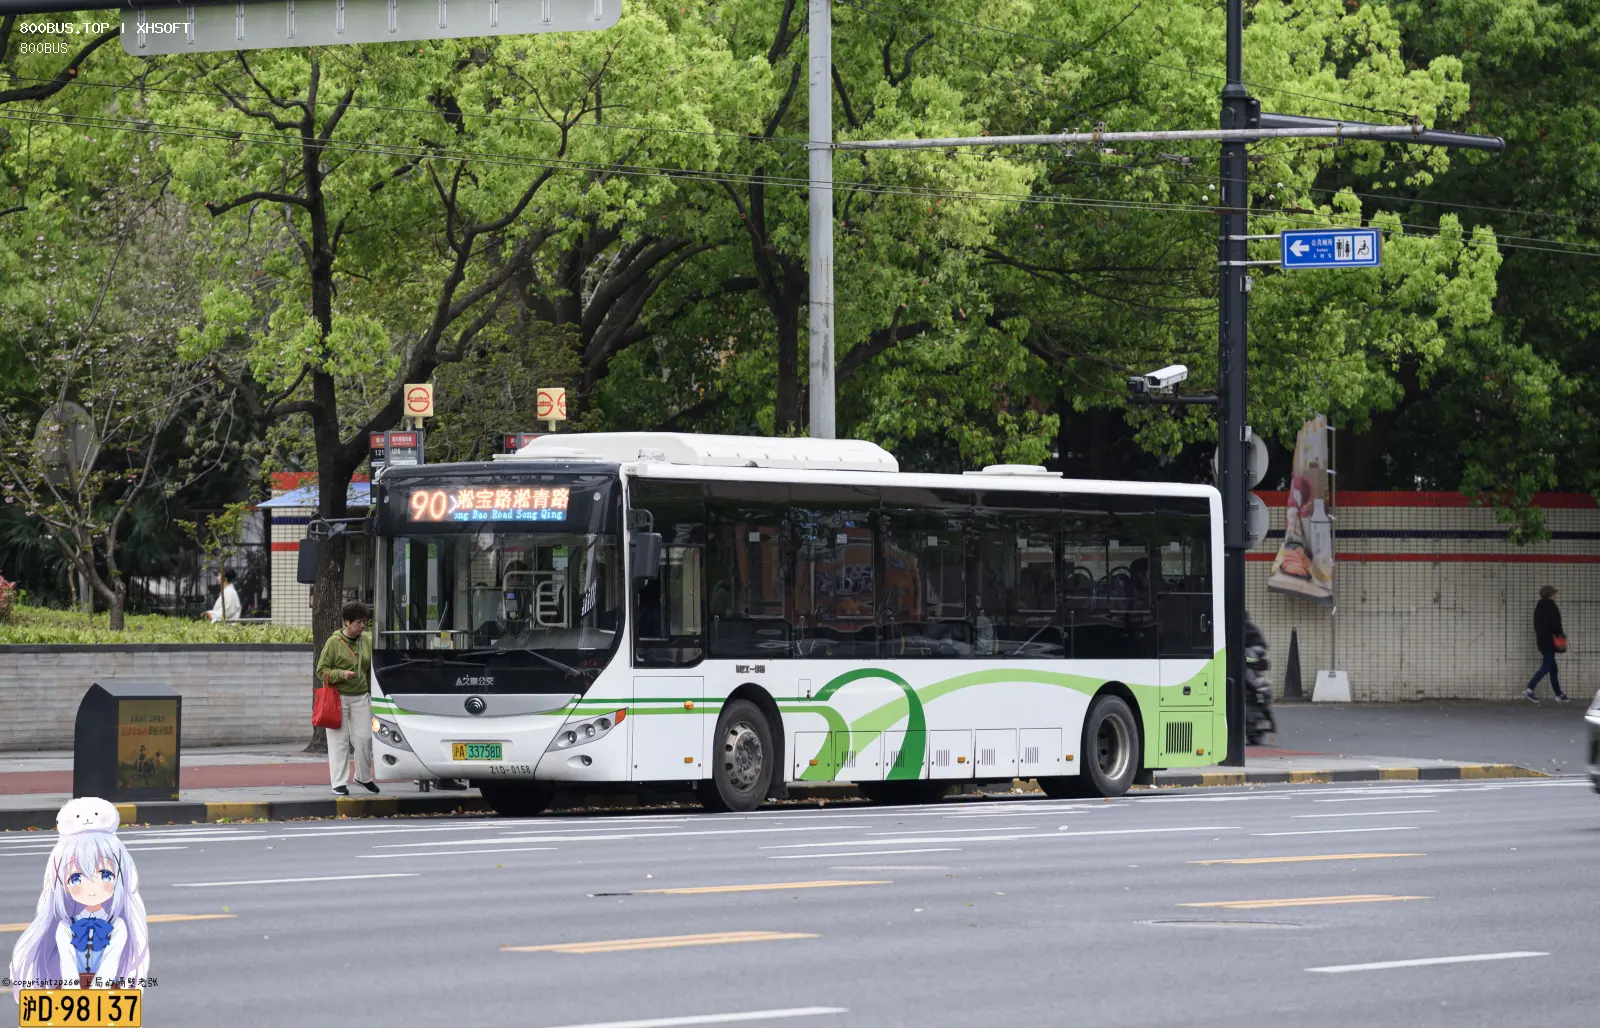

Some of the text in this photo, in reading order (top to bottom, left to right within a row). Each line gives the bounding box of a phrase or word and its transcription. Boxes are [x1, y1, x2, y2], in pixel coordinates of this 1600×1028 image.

[411, 490, 448, 520] 90
[457, 488, 570, 509] 淞宝路淞青路
[472, 510, 488, 520] Bao
[492, 509, 513, 520] Road
[516, 509, 537, 520] Song
[541, 509, 563, 520] Qing
